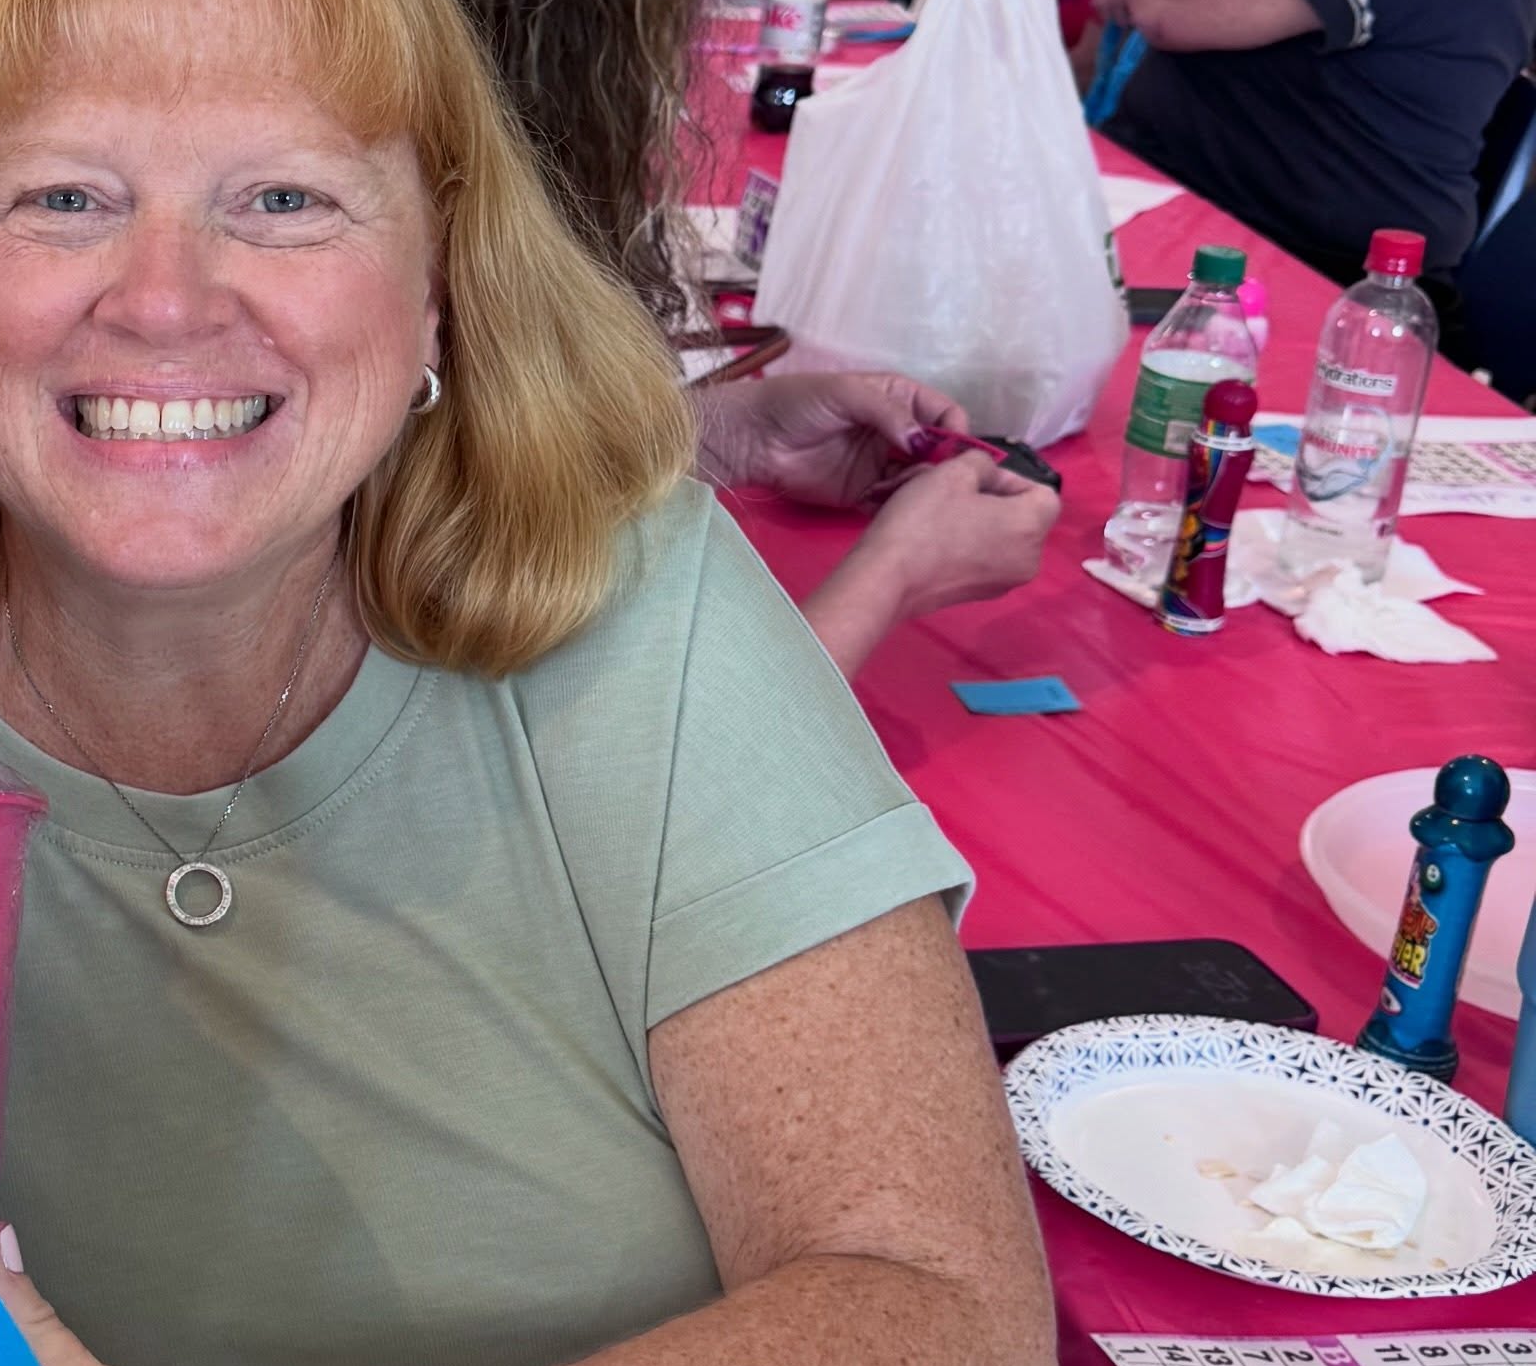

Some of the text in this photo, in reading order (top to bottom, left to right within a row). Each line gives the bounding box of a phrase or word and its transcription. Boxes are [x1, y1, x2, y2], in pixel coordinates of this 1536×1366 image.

[1119, 1346, 1146, 1355] 1
[1158, 1344, 1193, 1363] 14
[1374, 1344, 1411, 1362] 11
[1418, 1345, 1449, 1358] 8
[1461, 1343, 1492, 1356] 6
[1502, 1342, 1533, 1355] 3
[1198, 1346, 1233, 1366] 13
[1243, 1350, 1274, 1363] 7
[1283, 1350, 1314, 1363] 2
